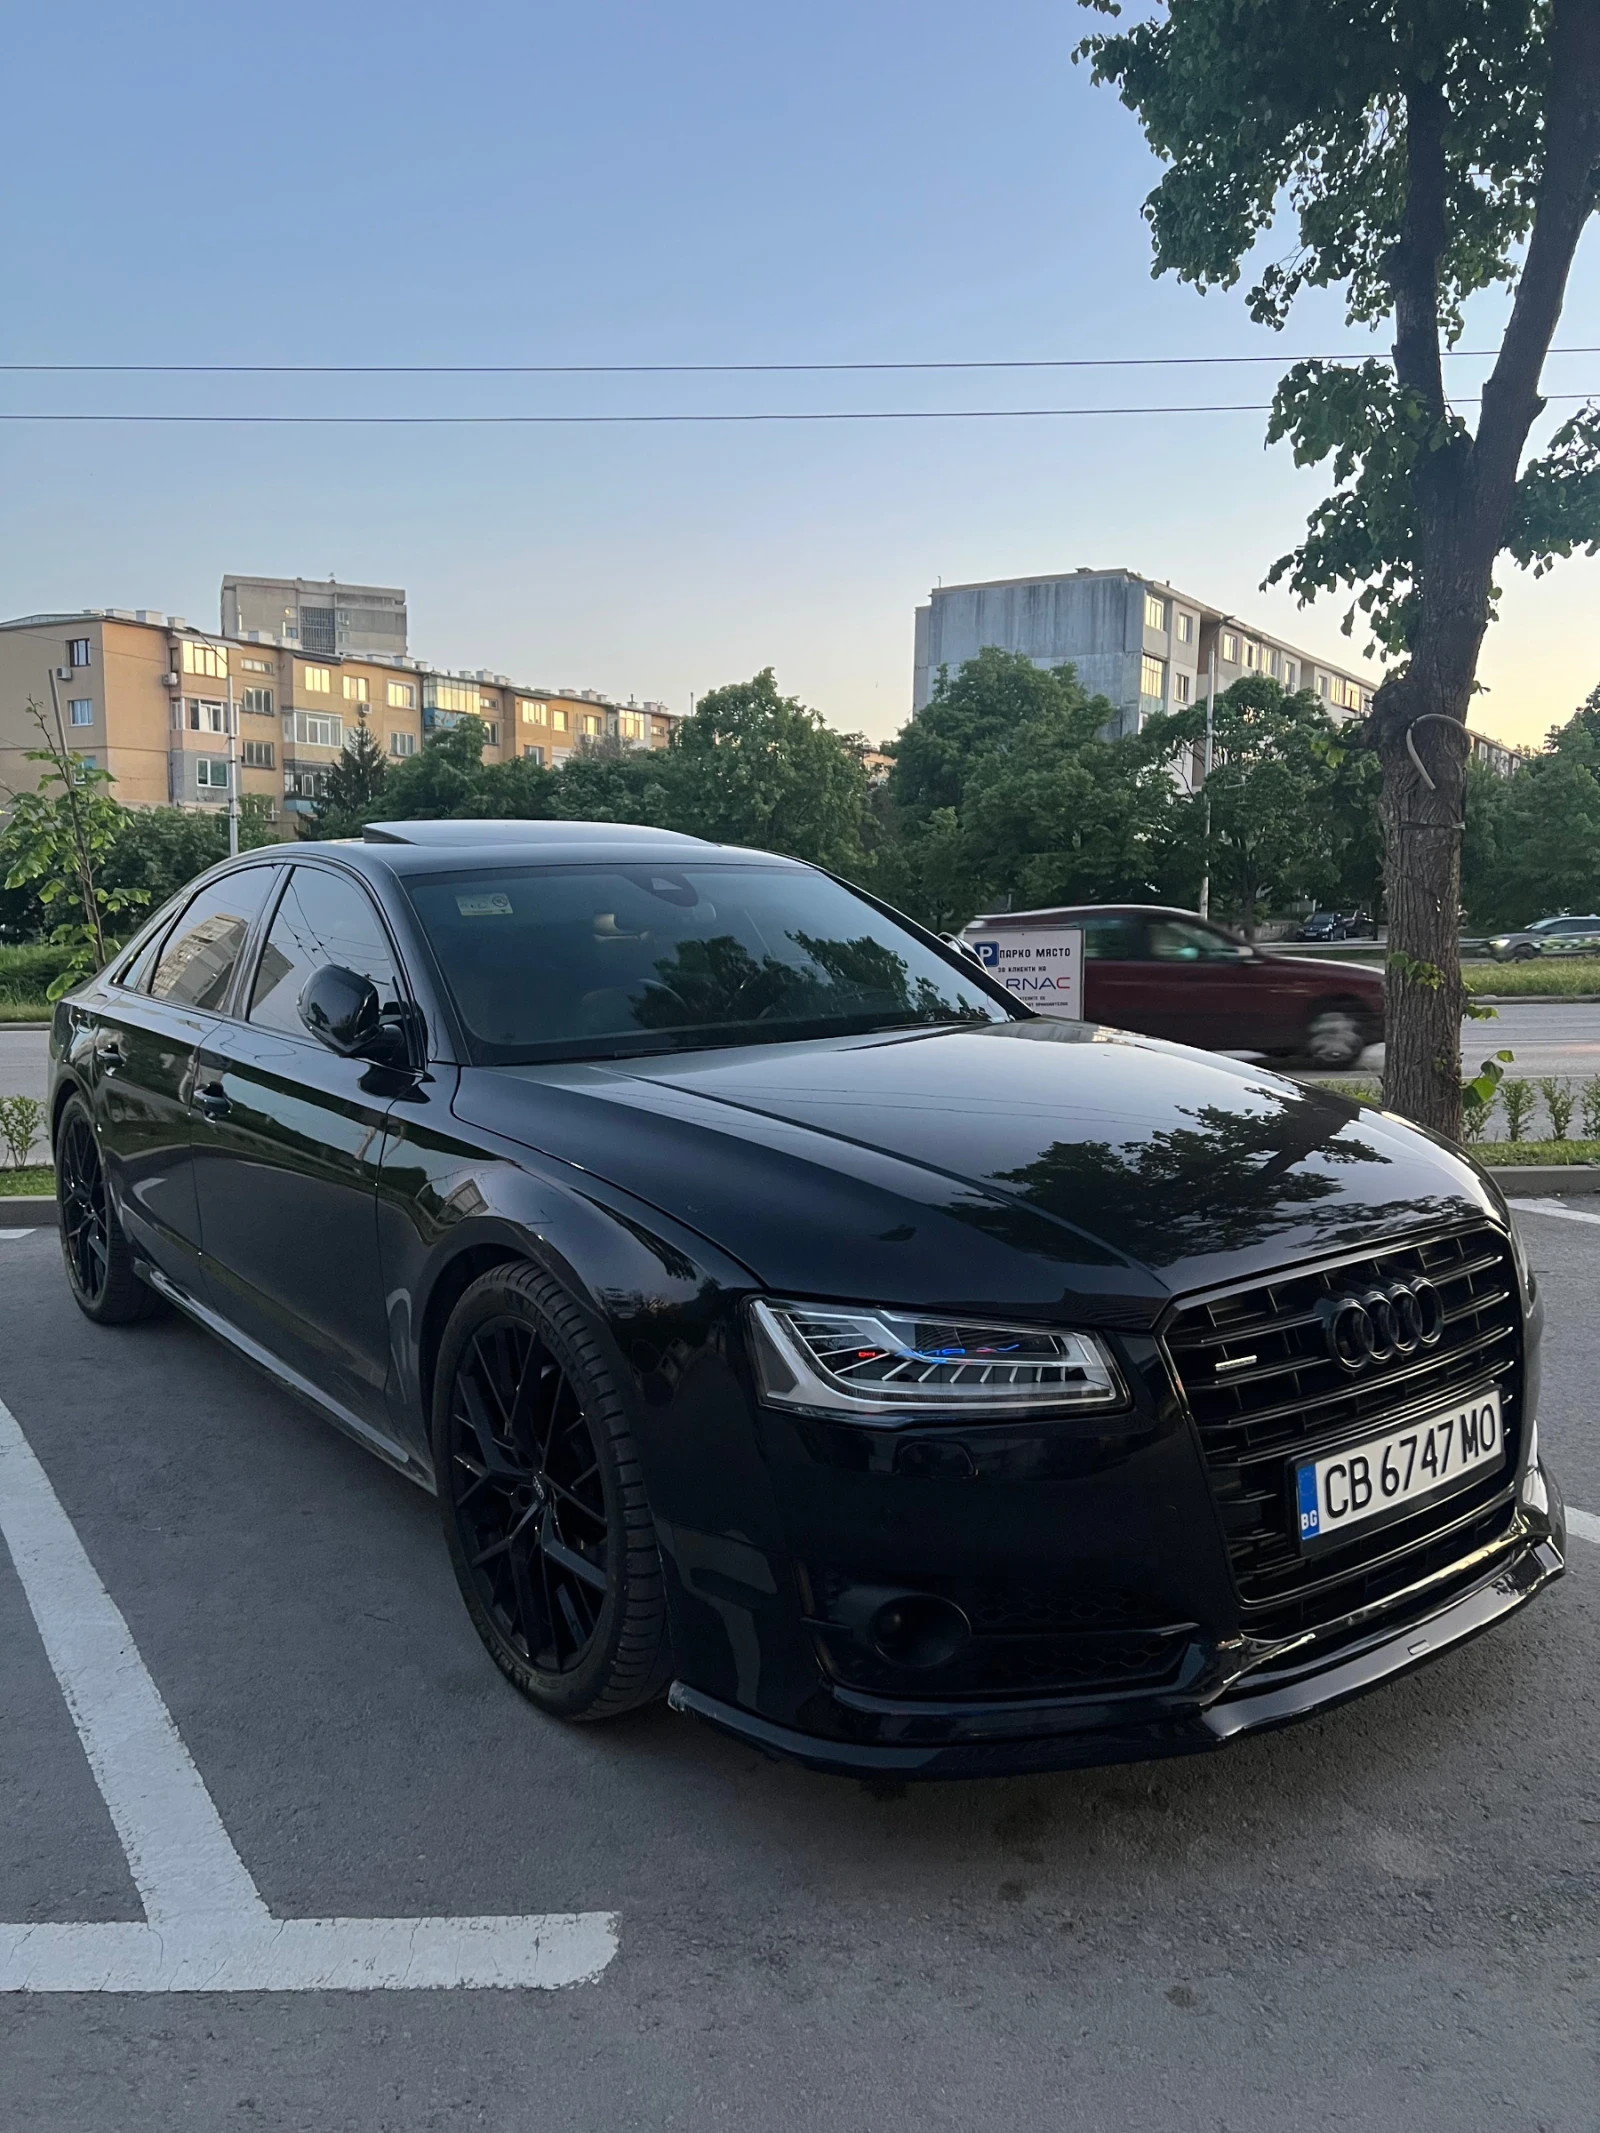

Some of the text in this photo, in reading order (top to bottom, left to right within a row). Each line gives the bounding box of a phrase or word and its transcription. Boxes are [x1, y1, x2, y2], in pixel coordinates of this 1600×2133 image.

[999, 947, 1071, 959] ПАРКО МЯСТО
[1005, 977, 1071, 991] RNAC
[1381, 1419, 1454, 1497] 6747
[1301, 1510, 1318, 1530] BG
